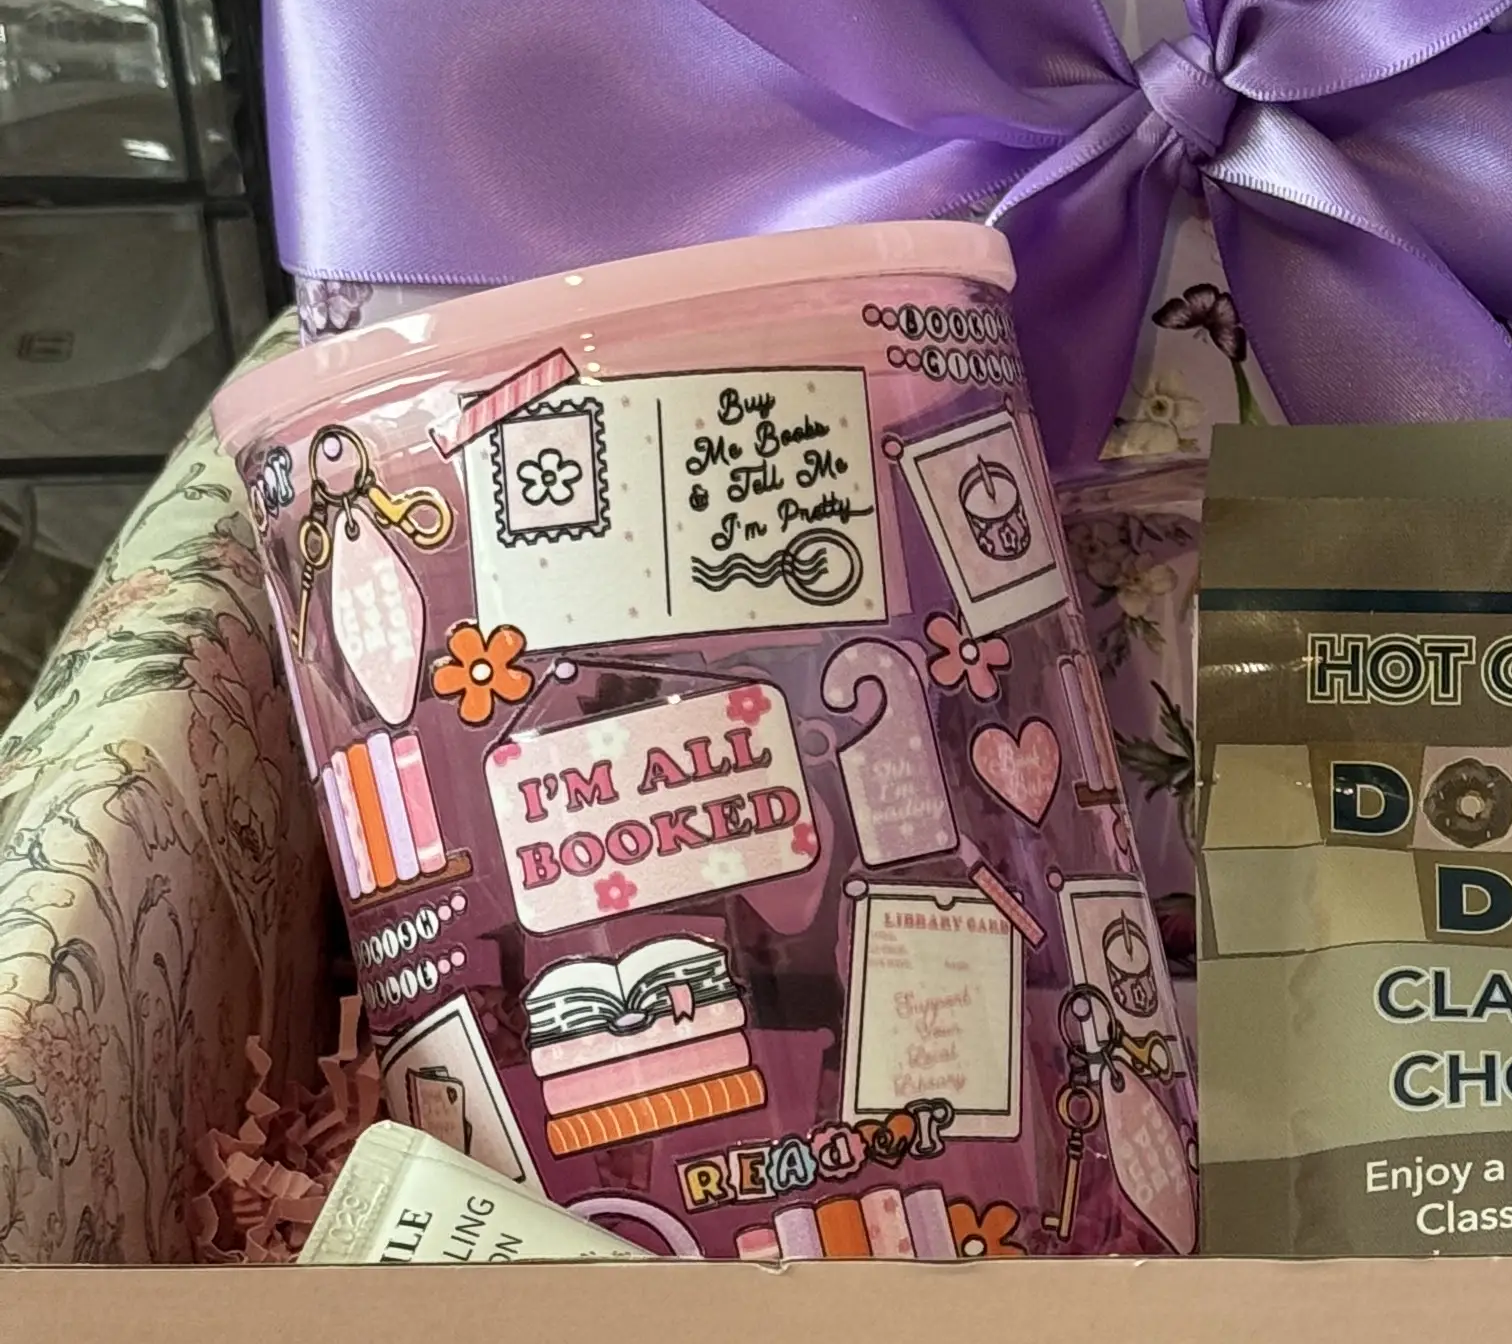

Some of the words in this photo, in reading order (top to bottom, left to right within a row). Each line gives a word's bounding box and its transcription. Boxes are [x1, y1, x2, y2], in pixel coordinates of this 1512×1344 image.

[717, 387, 776, 425] Buy
[686, 436, 743, 475] Me
[754, 414, 830, 457] Books
[727, 459, 784, 502] Tell
[796, 449, 849, 488] Me
[711, 512, 767, 551] I'm
[777, 491, 875, 532] Pretty
[1307, 633, 1475, 704] HOT
[518, 760, 620, 823] I'M
[637, 727, 772, 795] ALL
[516, 786, 801, 890] BOOKED
[884, 912, 964, 932] LIBRARY
[967, 916, 1009, 935] CARD
[1366, 1156, 1473, 1198] Enjoy
[1484, 1159, 1506, 1182] a
